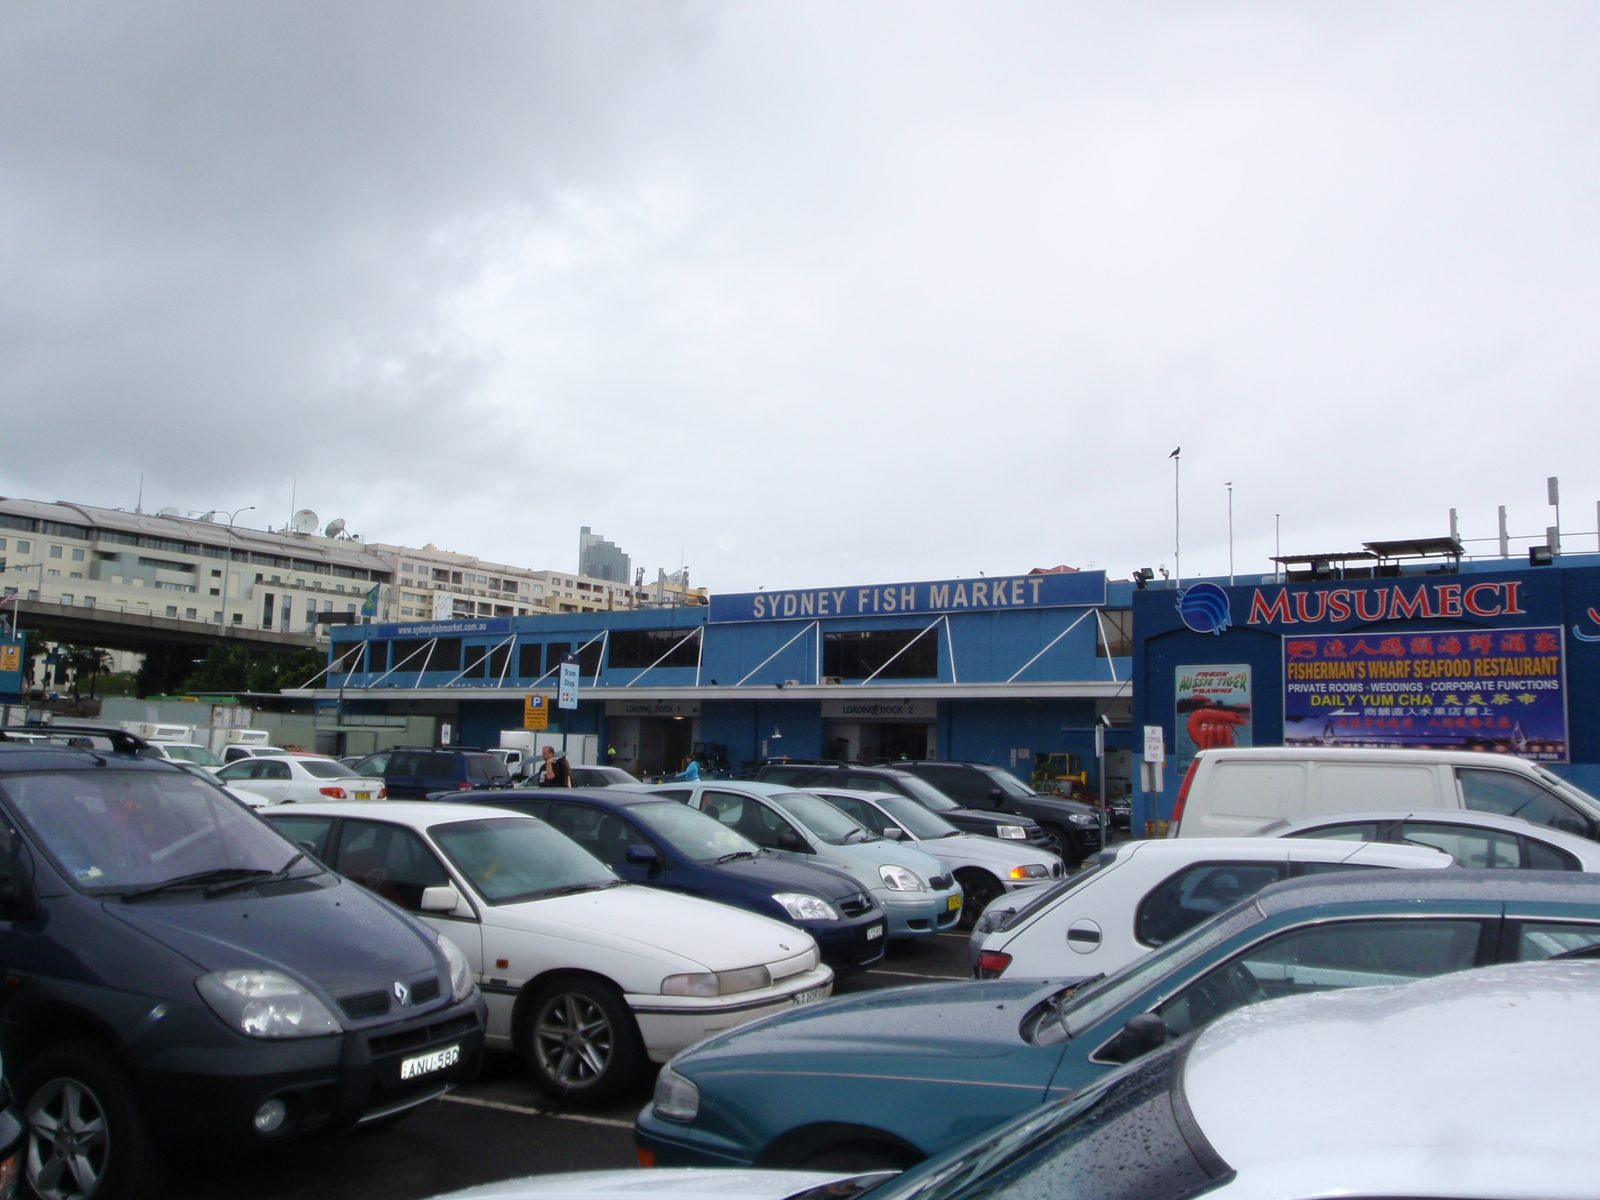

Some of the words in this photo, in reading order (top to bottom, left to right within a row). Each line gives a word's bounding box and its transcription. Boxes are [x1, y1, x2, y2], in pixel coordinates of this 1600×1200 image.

[753, 590, 847, 618] SYDNEY
[858, 586, 915, 613] FISH
[929, 578, 1044, 609] MARKET
[1247, 581, 1526, 625] MUSUMECI
[398, 623, 487, 636] www.sydneyfishmarket.com.au
[564, 668, 576, 677] Tram
[1288, 661, 1366, 679] FISHERMAN'S
[1368, 660, 1411, 678] WHARF
[1413, 658, 1471, 678] SEAFOOD
[1474, 656, 1559, 676] RESTAURANT
[564, 678, 575, 688] Stop
[1288, 683, 1326, 693] PRIVATE
[1328, 683, 1364, 692] ROOMS
[1370, 682, 1423, 692] WEDDINGS
[1431, 681, 1495, 691] CORPORATE
[1497, 680, 1559, 690] FUNCTIONS
[533, 696, 541, 707] P
[1311, 694, 1356, 706] DAILY
[1360, 694, 1394, 706] YUM
[1398, 694, 1433, 706] CHA
[880, 705, 903, 714] DOCK
[907, 705, 914, 714] 2
